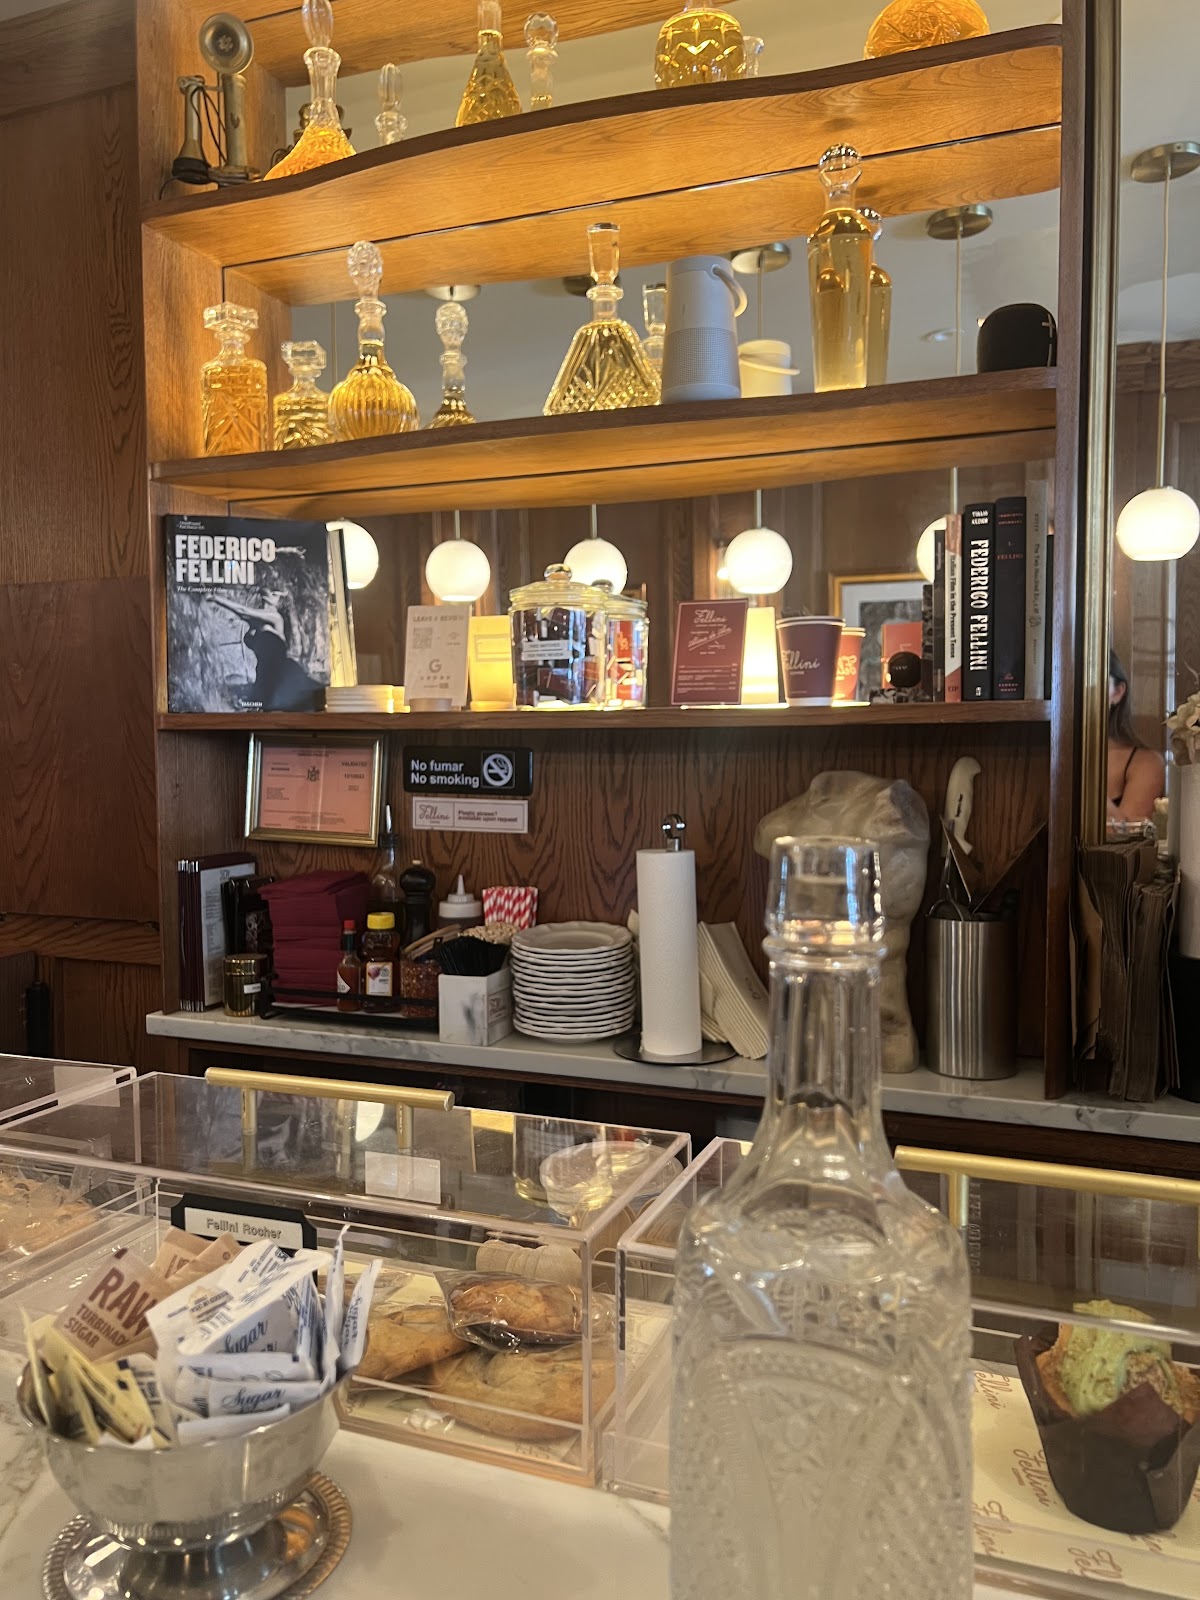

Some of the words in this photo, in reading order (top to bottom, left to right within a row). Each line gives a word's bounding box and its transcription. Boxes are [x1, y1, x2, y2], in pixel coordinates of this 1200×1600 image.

[176, 534, 276, 563] FEDERICO
[176, 558, 255, 585] FELLINI
[970, 539, 989, 608] FEDERICO
[969, 614, 988, 670] FELLINI
[411, 759, 427, 771] No
[430, 760, 464, 772] fumar
[411, 773, 427, 784] No
[430, 773, 480, 788] smoking
[419, 804, 450, 820] Fellini
[206, 1217, 238, 1233] Fellini
[242, 1220, 282, 1240] Rocher
[88, 1266, 158, 1337] RAW
[64, 1316, 100, 1348] SUGAR
[222, 1386, 286, 1410] Sugar
[1013, 1447, 1058, 1507] Fellini
